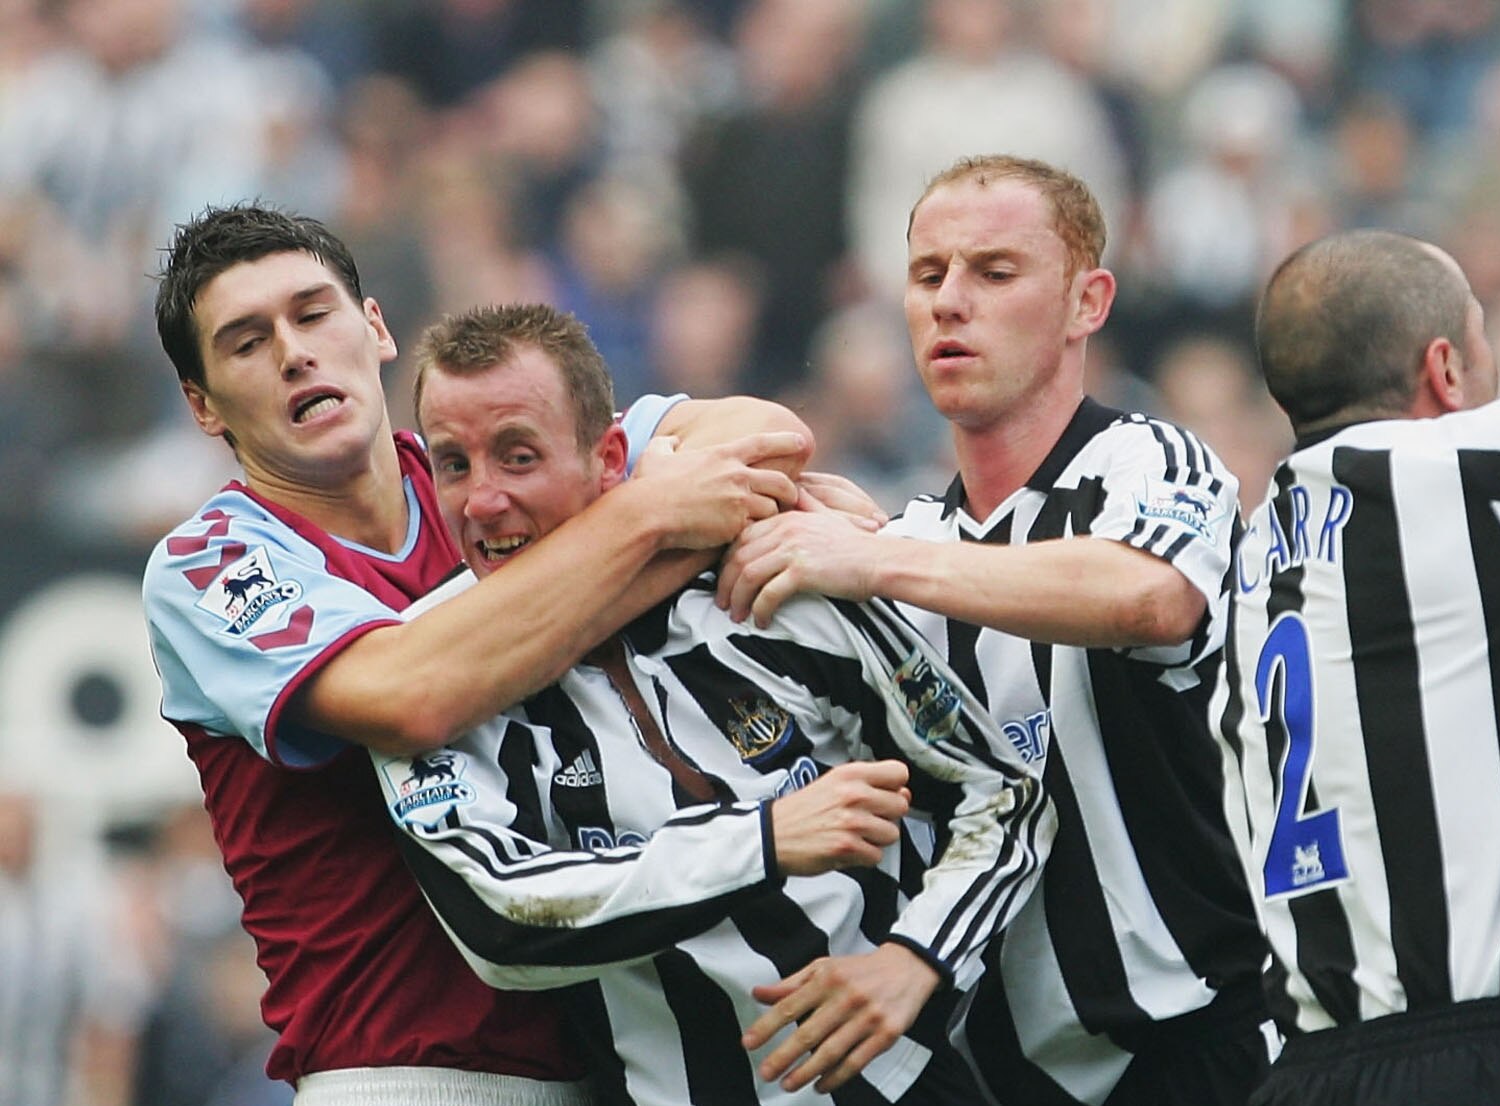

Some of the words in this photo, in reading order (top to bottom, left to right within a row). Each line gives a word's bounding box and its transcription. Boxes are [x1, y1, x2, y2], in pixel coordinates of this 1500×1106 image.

[1236, 485, 1353, 594] CARR
[234, 589, 282, 632] BARCLAYS
[1256, 611, 1350, 899] 2
